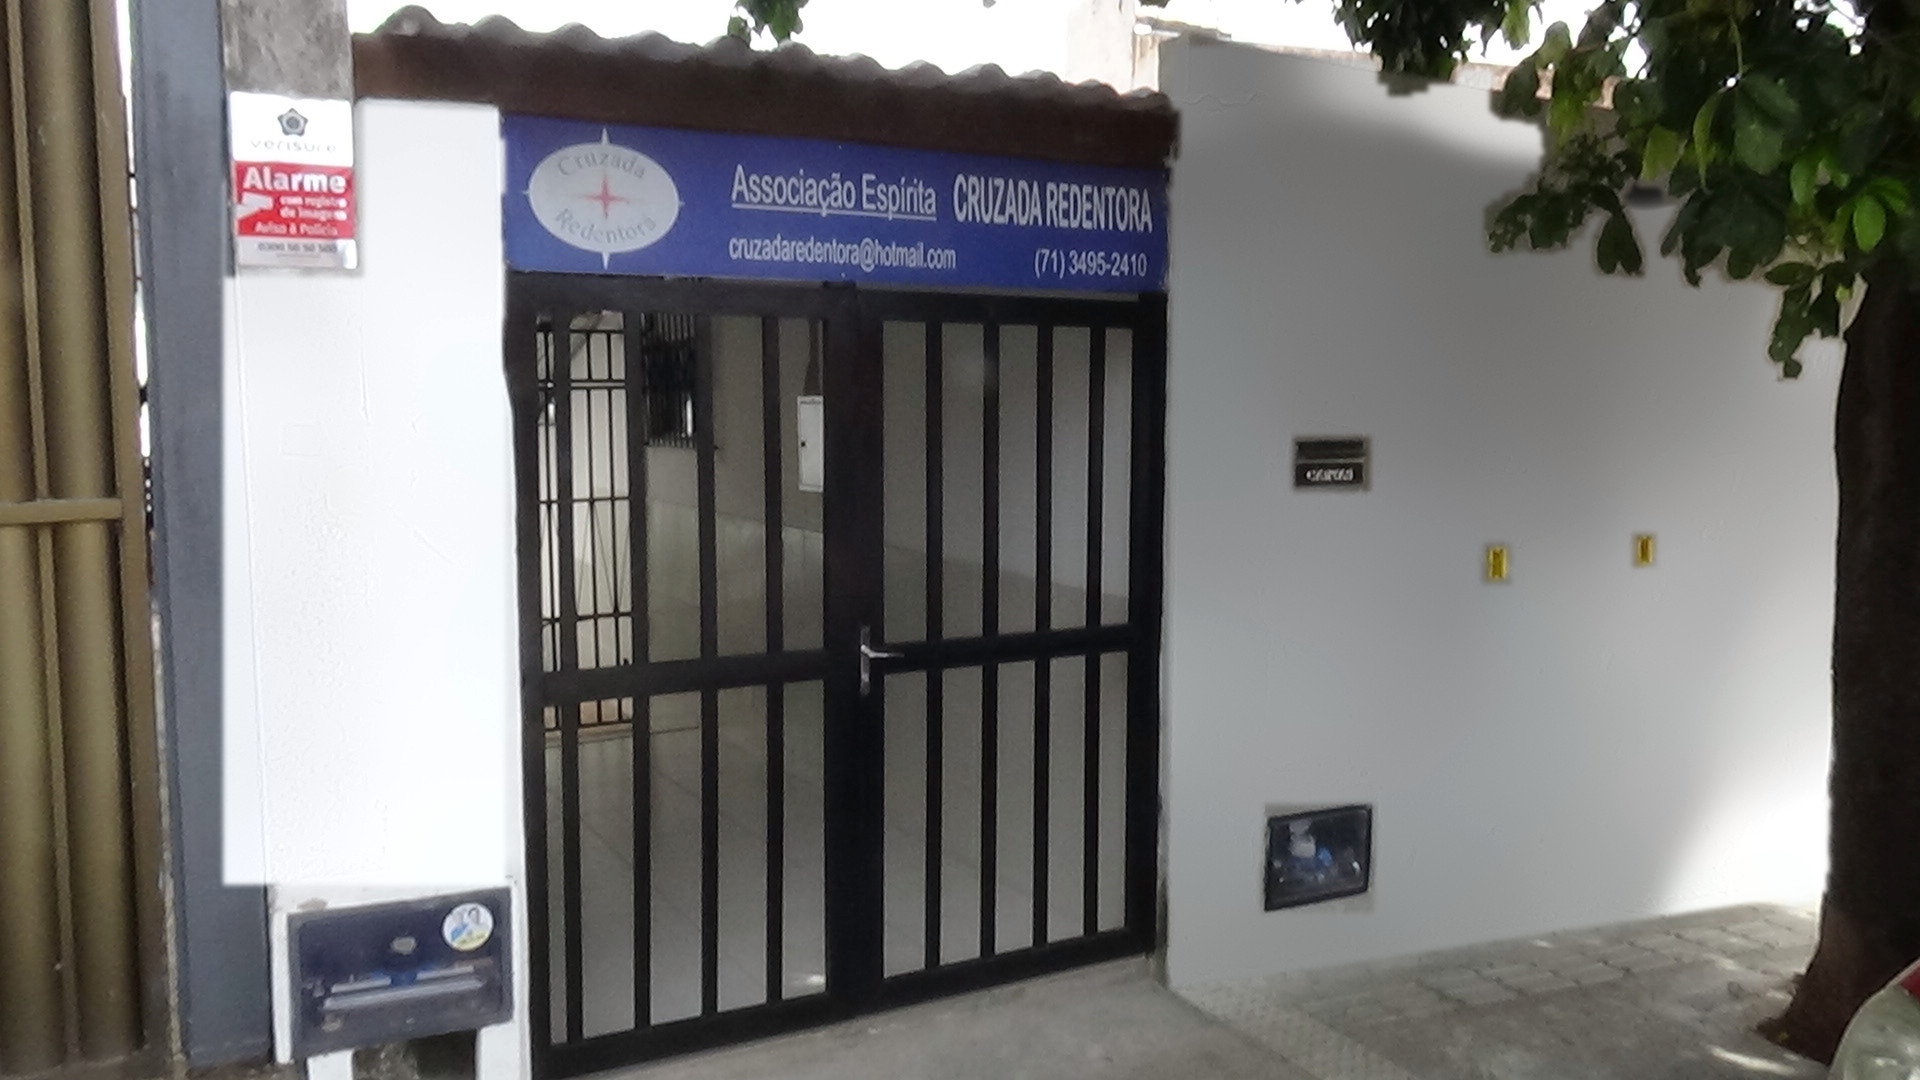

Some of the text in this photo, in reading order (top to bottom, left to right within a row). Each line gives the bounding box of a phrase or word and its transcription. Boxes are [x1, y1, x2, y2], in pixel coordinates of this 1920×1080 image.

[251, 140, 336, 153] verisure
[242, 166, 347, 194] Alarme
[557, 152, 647, 180] Cruzada
[731, 164, 1153, 233] Associação Espírita CRUZADA REDENTORA
[554, 208, 658, 244] Redentora
[729, 233, 956, 273] cruzadaredentora@hotmail.com
[1034, 248, 1148, 279] (71) 3495-2410
